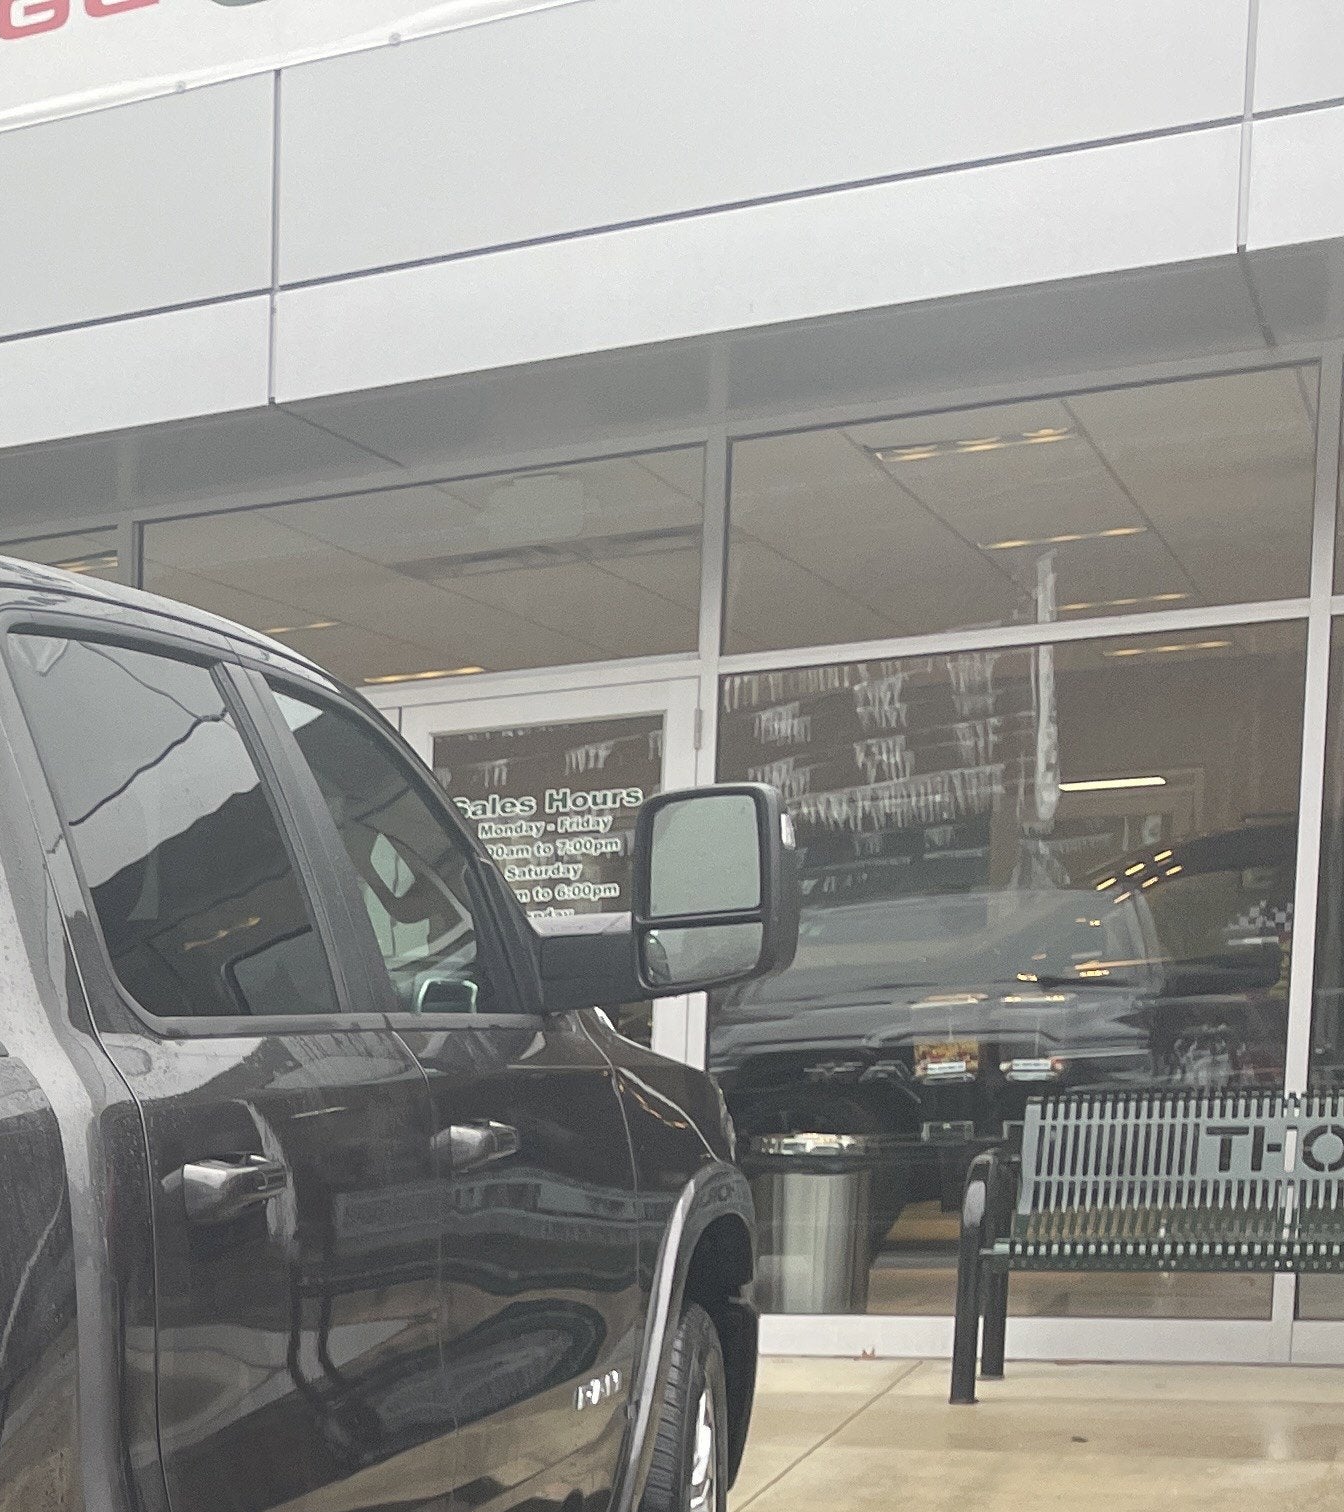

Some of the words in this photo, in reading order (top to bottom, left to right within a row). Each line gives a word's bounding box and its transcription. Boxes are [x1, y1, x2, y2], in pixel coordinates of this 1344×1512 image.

[453, 794, 537, 819] Sales
[545, 788, 643, 813] Hours
[478, 820, 545, 838] Monday
[558, 815, 612, 833] Friday
[533, 841, 554, 857] to
[504, 862, 583, 881] Saturday
[532, 886, 552, 902] to
[554, 882, 620, 900] 6:00pm
